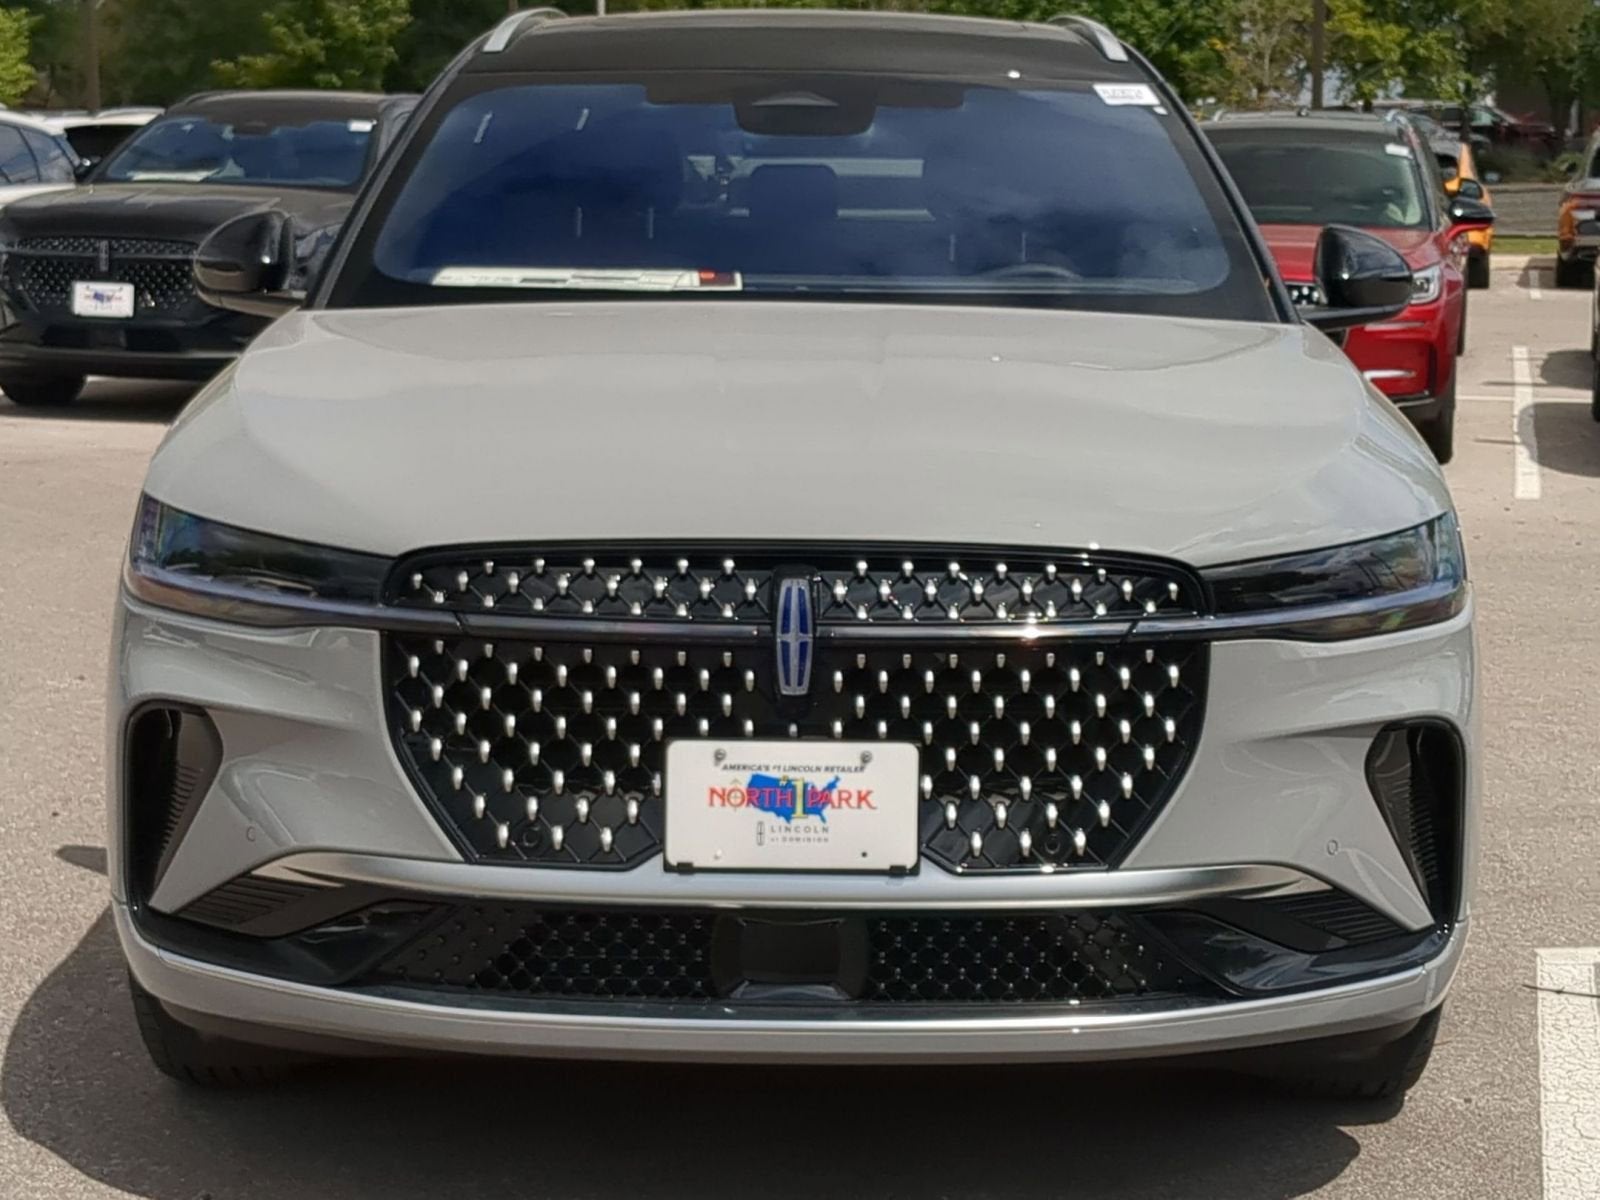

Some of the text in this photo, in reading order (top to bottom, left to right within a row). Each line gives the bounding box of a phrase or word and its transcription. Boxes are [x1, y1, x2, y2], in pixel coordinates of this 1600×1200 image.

[721, 764, 770, 772] AMERICA'S
[783, 765, 822, 773] LINCOLN
[824, 765, 866, 773] RETAILER
[708, 787, 877, 810] NORTH PARK
[770, 825, 829, 833] LINCOLN
